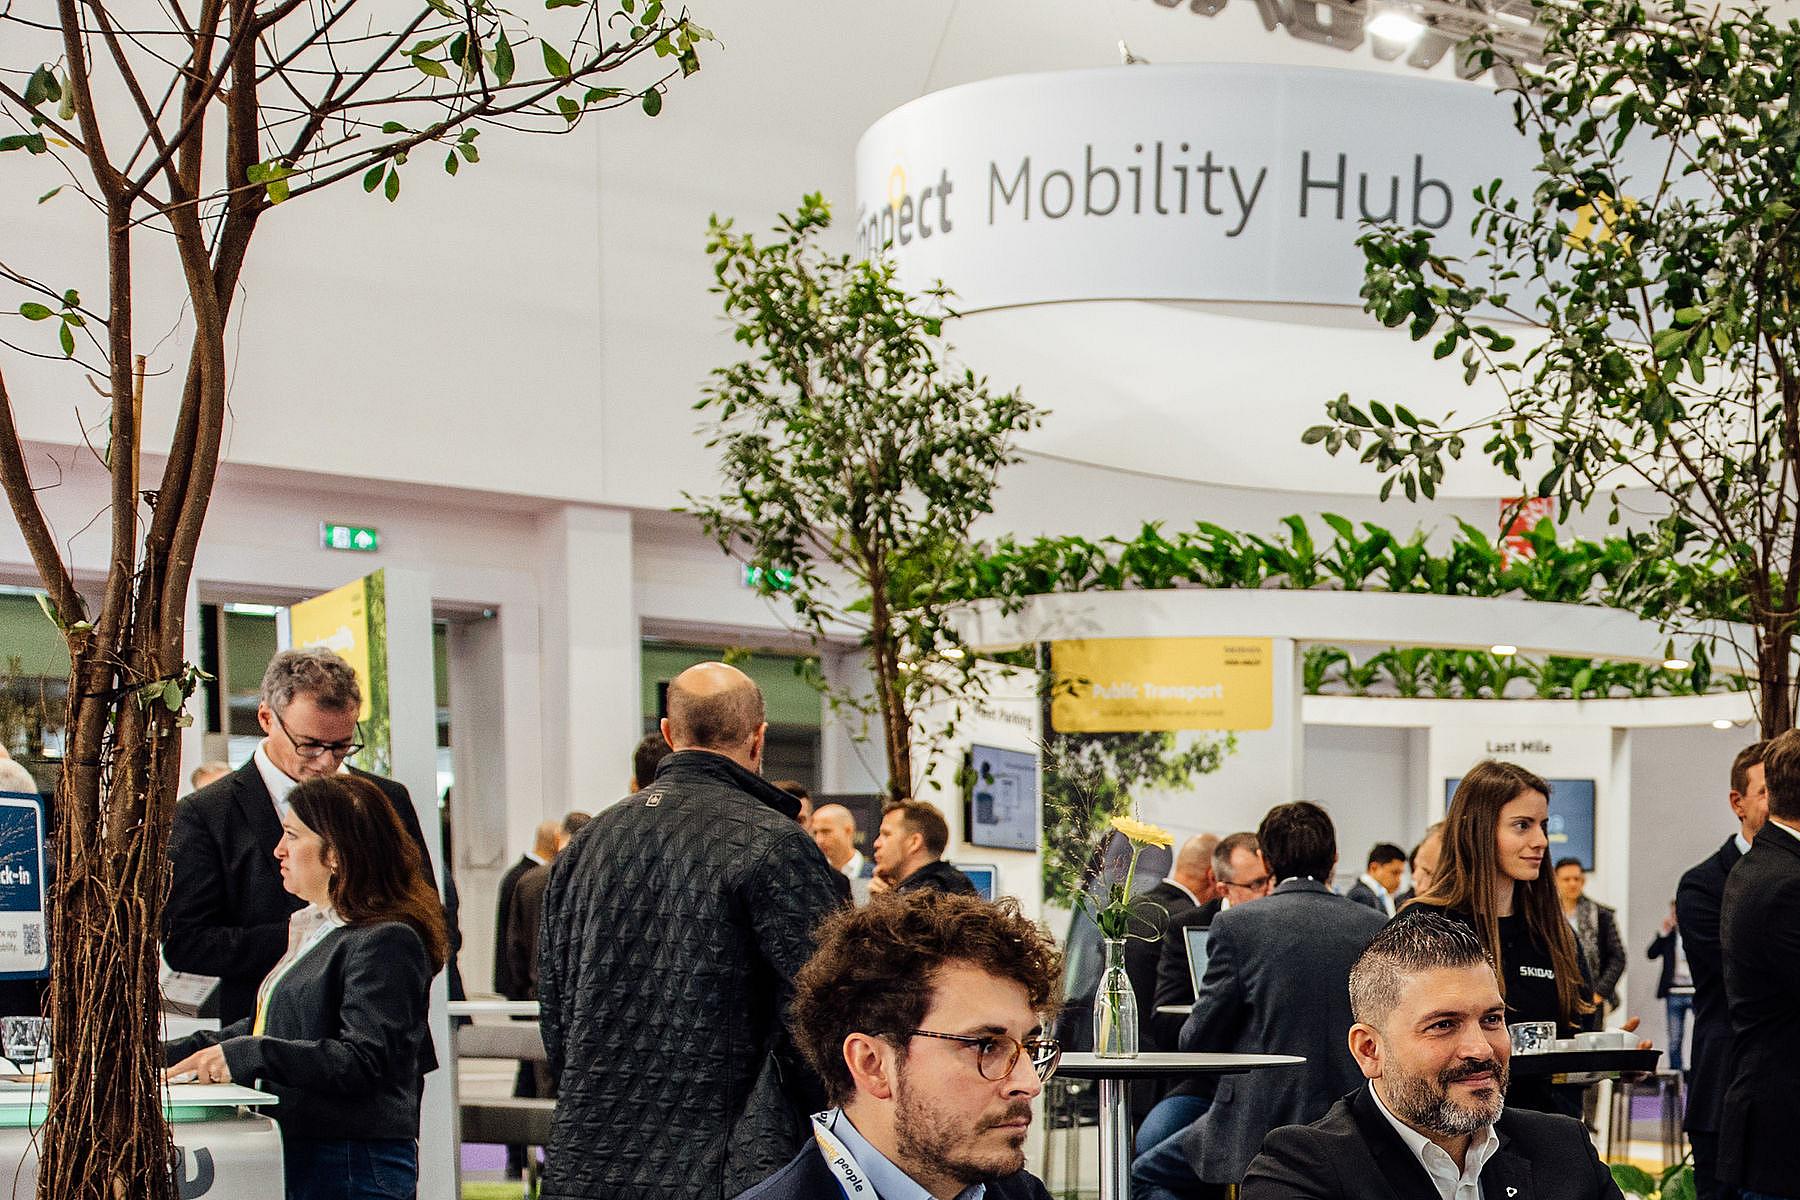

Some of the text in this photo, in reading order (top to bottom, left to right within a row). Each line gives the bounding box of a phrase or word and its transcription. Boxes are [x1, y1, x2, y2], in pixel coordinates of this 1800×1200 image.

[988, 141, 1268, 238] Mobility
[1298, 149, 1455, 230] Hub
[1092, 682, 1224, 703] Public Transport
[1486, 740, 1552, 753] Last Mile
[834, 1158, 863, 1193] people
